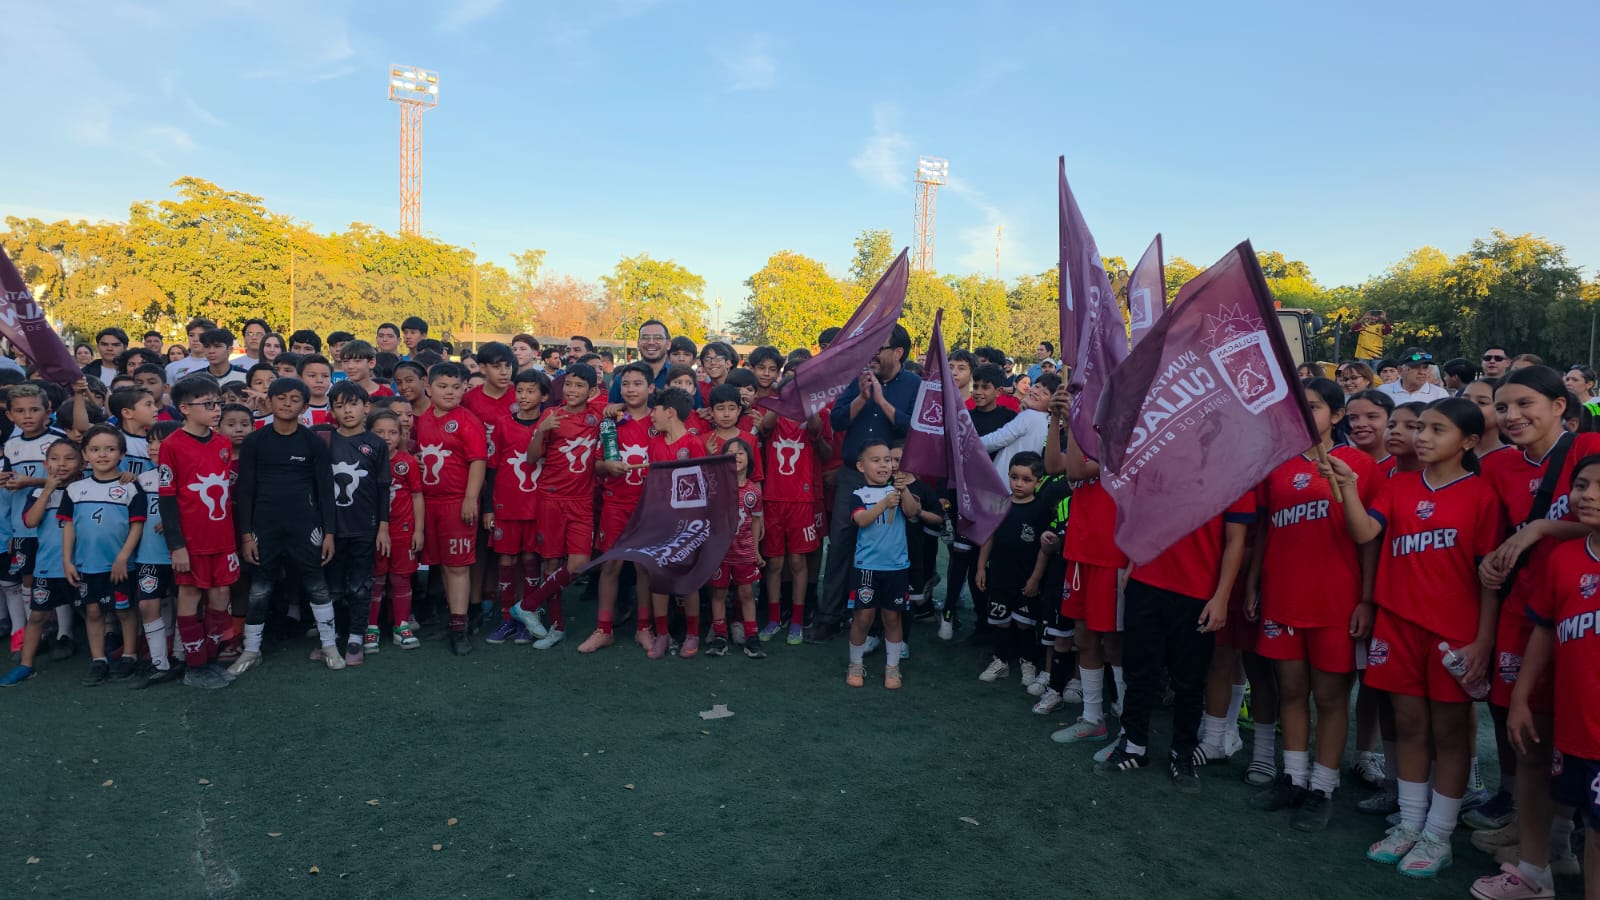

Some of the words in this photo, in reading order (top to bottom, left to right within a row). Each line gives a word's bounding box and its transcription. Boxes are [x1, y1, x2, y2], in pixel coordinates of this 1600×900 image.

[91, 507, 104, 524] 4
[449, 538, 471, 555] 214
[1392, 529, 1458, 557] YIMPER
[990, 601, 1007, 618] 29
